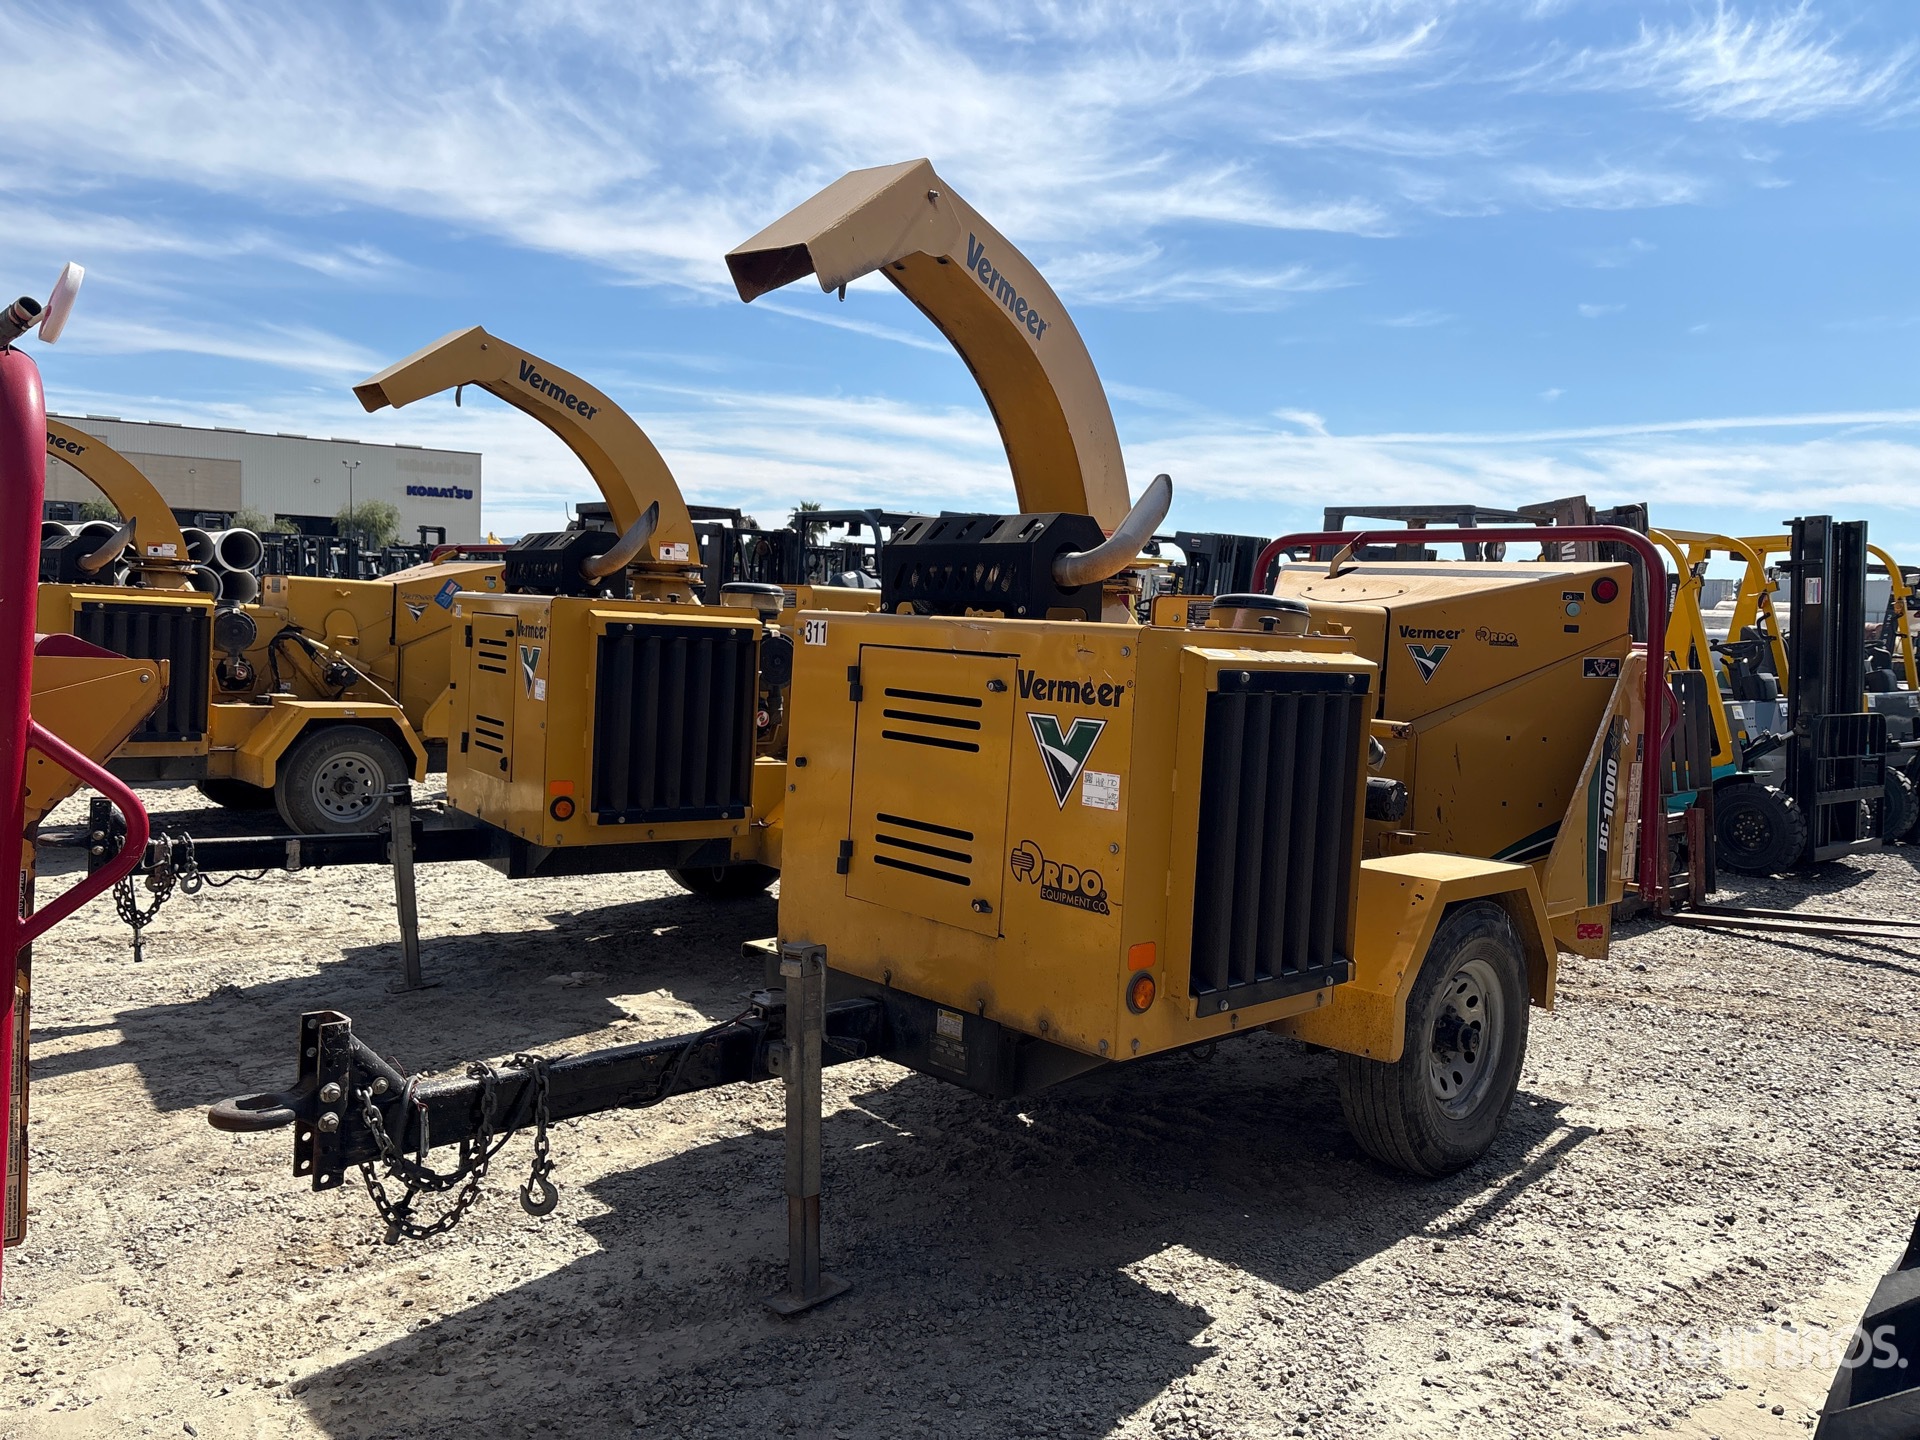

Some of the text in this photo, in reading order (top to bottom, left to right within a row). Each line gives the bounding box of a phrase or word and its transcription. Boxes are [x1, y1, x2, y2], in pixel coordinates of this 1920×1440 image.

[966, 231, 1047, 341] Vermeer
[519, 359, 597, 420] Vermeer
[46, 431, 86, 456] meer
[406, 485, 473, 500] KOMATSU
[517, 619, 547, 639] Vermeer
[805, 621, 827, 643] 311
[1399, 625, 1460, 640] Vermeer
[1018, 669, 1125, 708] Vermeer
[1041, 887, 1110, 915] EQUIPMENT CO.
